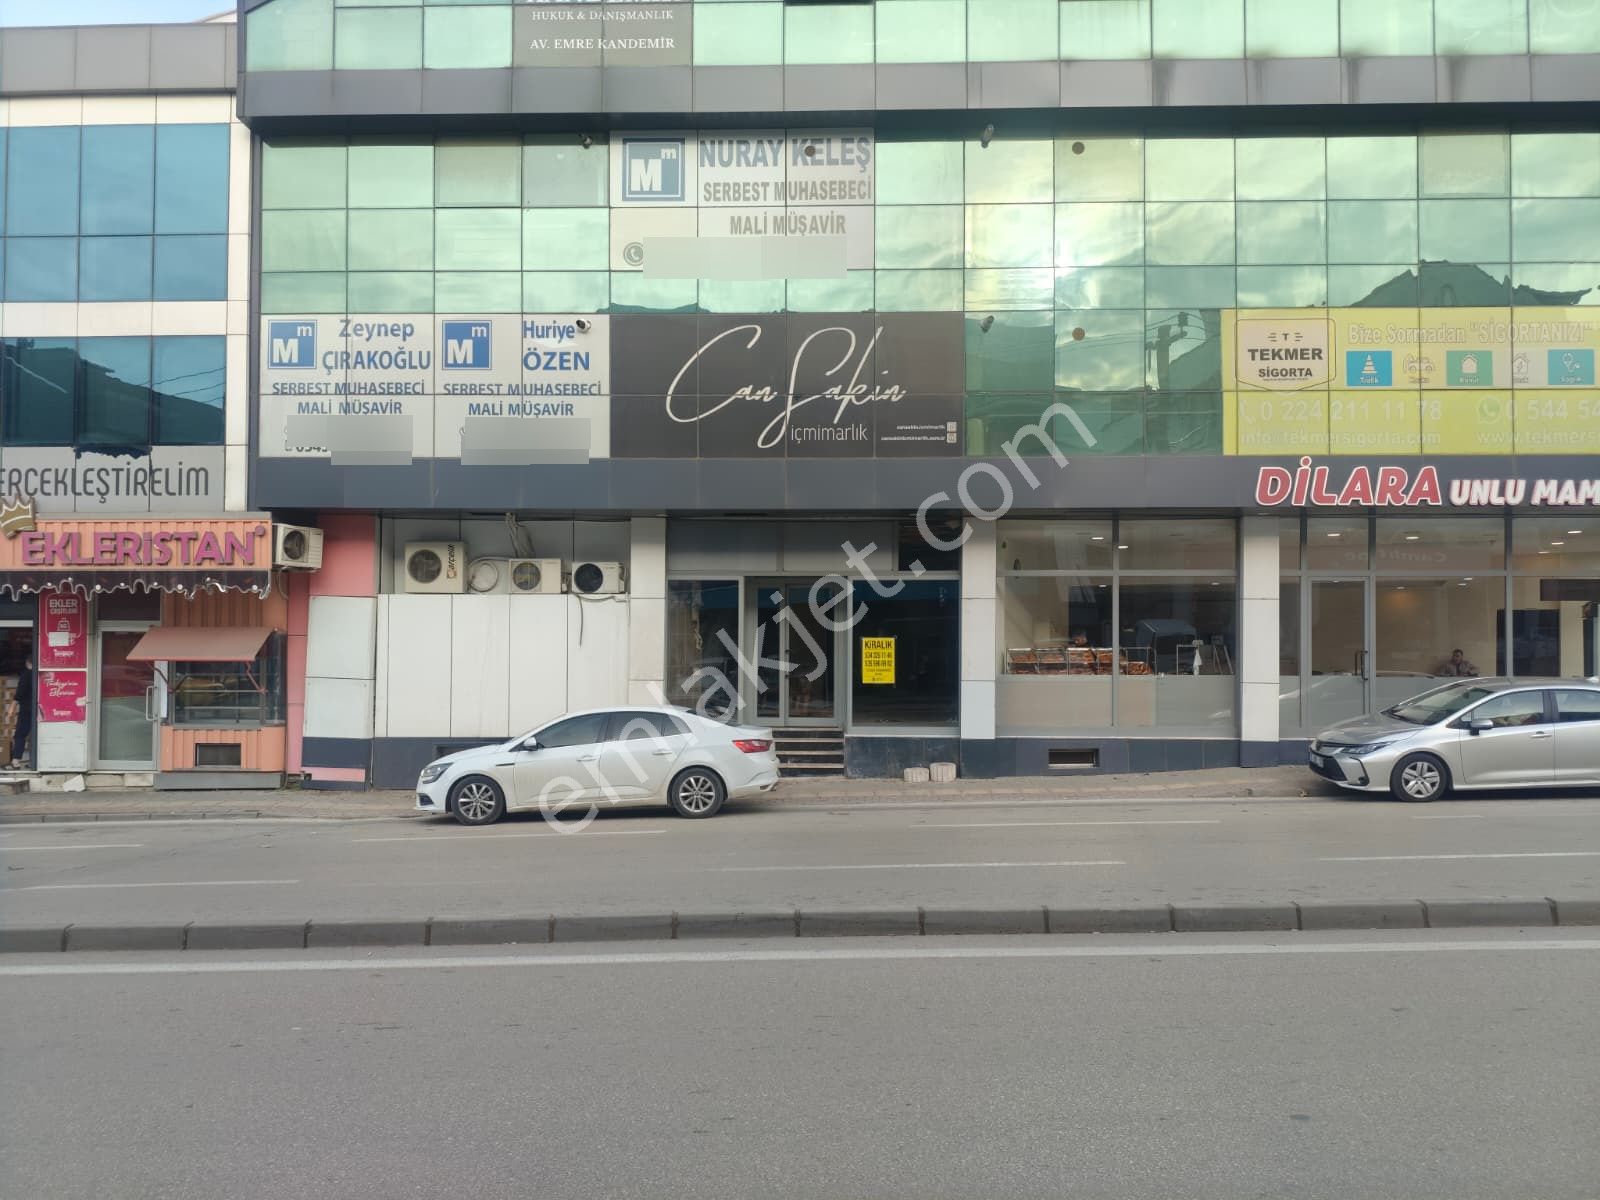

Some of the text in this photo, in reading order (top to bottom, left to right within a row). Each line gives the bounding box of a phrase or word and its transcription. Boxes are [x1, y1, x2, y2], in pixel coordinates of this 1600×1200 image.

[532, 10, 673, 22] HUKUK & DANIŞMANLIK
[530, 36, 675, 49] AV. EMRE KANDEMİR
[699, 136, 871, 173] NURAY KELEŞ
[703, 176, 872, 202] SERBEST MUHASEBECİ
[730, 210, 846, 236] MALİ MÜŞAVİR
[338, 319, 415, 341] Zeynep
[522, 320, 576, 344] Huriye
[1348, 323, 1382, 344] Bize
[1386, 322, 1466, 344] Sormadan
[322, 347, 431, 375] ÇIRAKOĞLU
[522, 349, 590, 371] ÖZEN
[1247, 347, 1323, 361] TEKMER
[1258, 366, 1313, 378] SİGORTA
[272, 380, 425, 395] SERBEST MUHASEBECİ
[443, 381, 601, 396] SERBEST MUHASEBECİ
[297, 398, 403, 416] MALİ MÜŞAVİR
[468, 401, 574, 417] MALİ MÜŞAVİR
[1282, 400, 1322, 421] 224
[1331, 400, 1370, 420] 211
[1382, 400, 1406, 420] 11
[1416, 399, 1441, 420] 78
[1528, 399, 1568, 419] 544
[791, 423, 868, 444] içmimarlık
[1255, 456, 1443, 506] DİLARA
[1449, 479, 1527, 506] UNLU
[49, 599, 78, 608] EKLER
